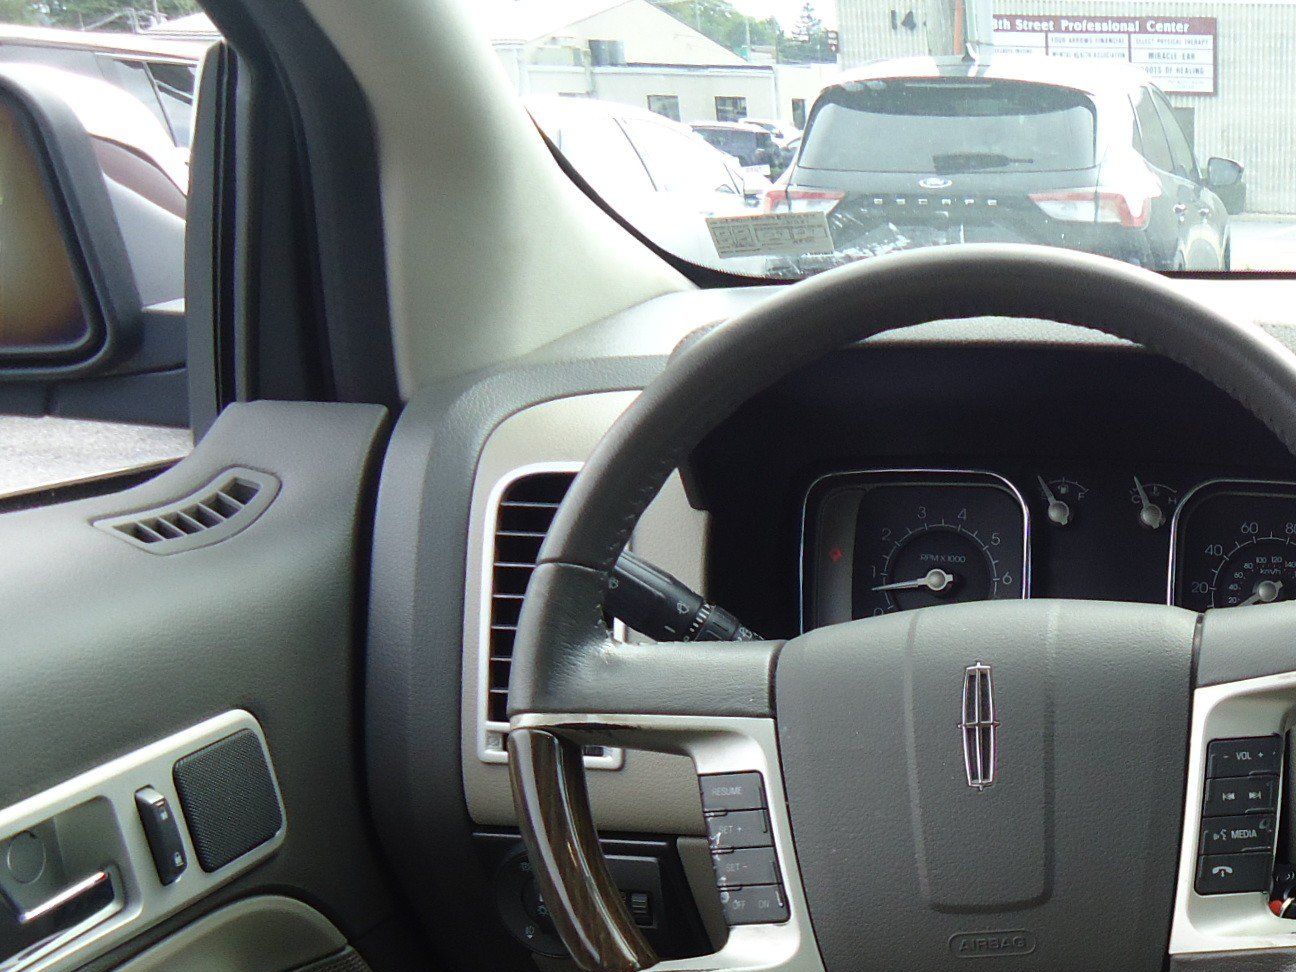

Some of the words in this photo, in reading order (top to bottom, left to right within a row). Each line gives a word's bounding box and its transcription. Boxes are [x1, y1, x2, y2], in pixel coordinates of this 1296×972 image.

[1016, 19, 1055, 31] Street
[1061, 19, 1140, 32] Professional
[1146, 20, 1190, 33] Center
[917, 506, 927, 519] 3
[957, 508, 967, 521] 4
[1240, 522, 1259, 534] 60
[881, 528, 892, 541] 2
[990, 532, 1001, 546] 5
[1204, 544, 1223, 556] 40
[920, 554, 940, 562] RPM
[947, 555, 966, 563] 1000
[871, 565, 877, 578] 1
[1243, 562, 1253, 570] 80
[1003, 571, 1013, 585] 6
[1234, 571, 1244, 579] 60
[1191, 581, 1209, 594] 20
[1228, 596, 1237, 604] 20
[1236, 752, 1252, 760] VOL
[712, 786, 743, 796] RESUME
[719, 825, 735, 834] SET
[1231, 829, 1257, 839] MEDIA
[725, 862, 741, 871] SET
[732, 900, 746, 910] OFF
[757, 899, 771, 909] ON
